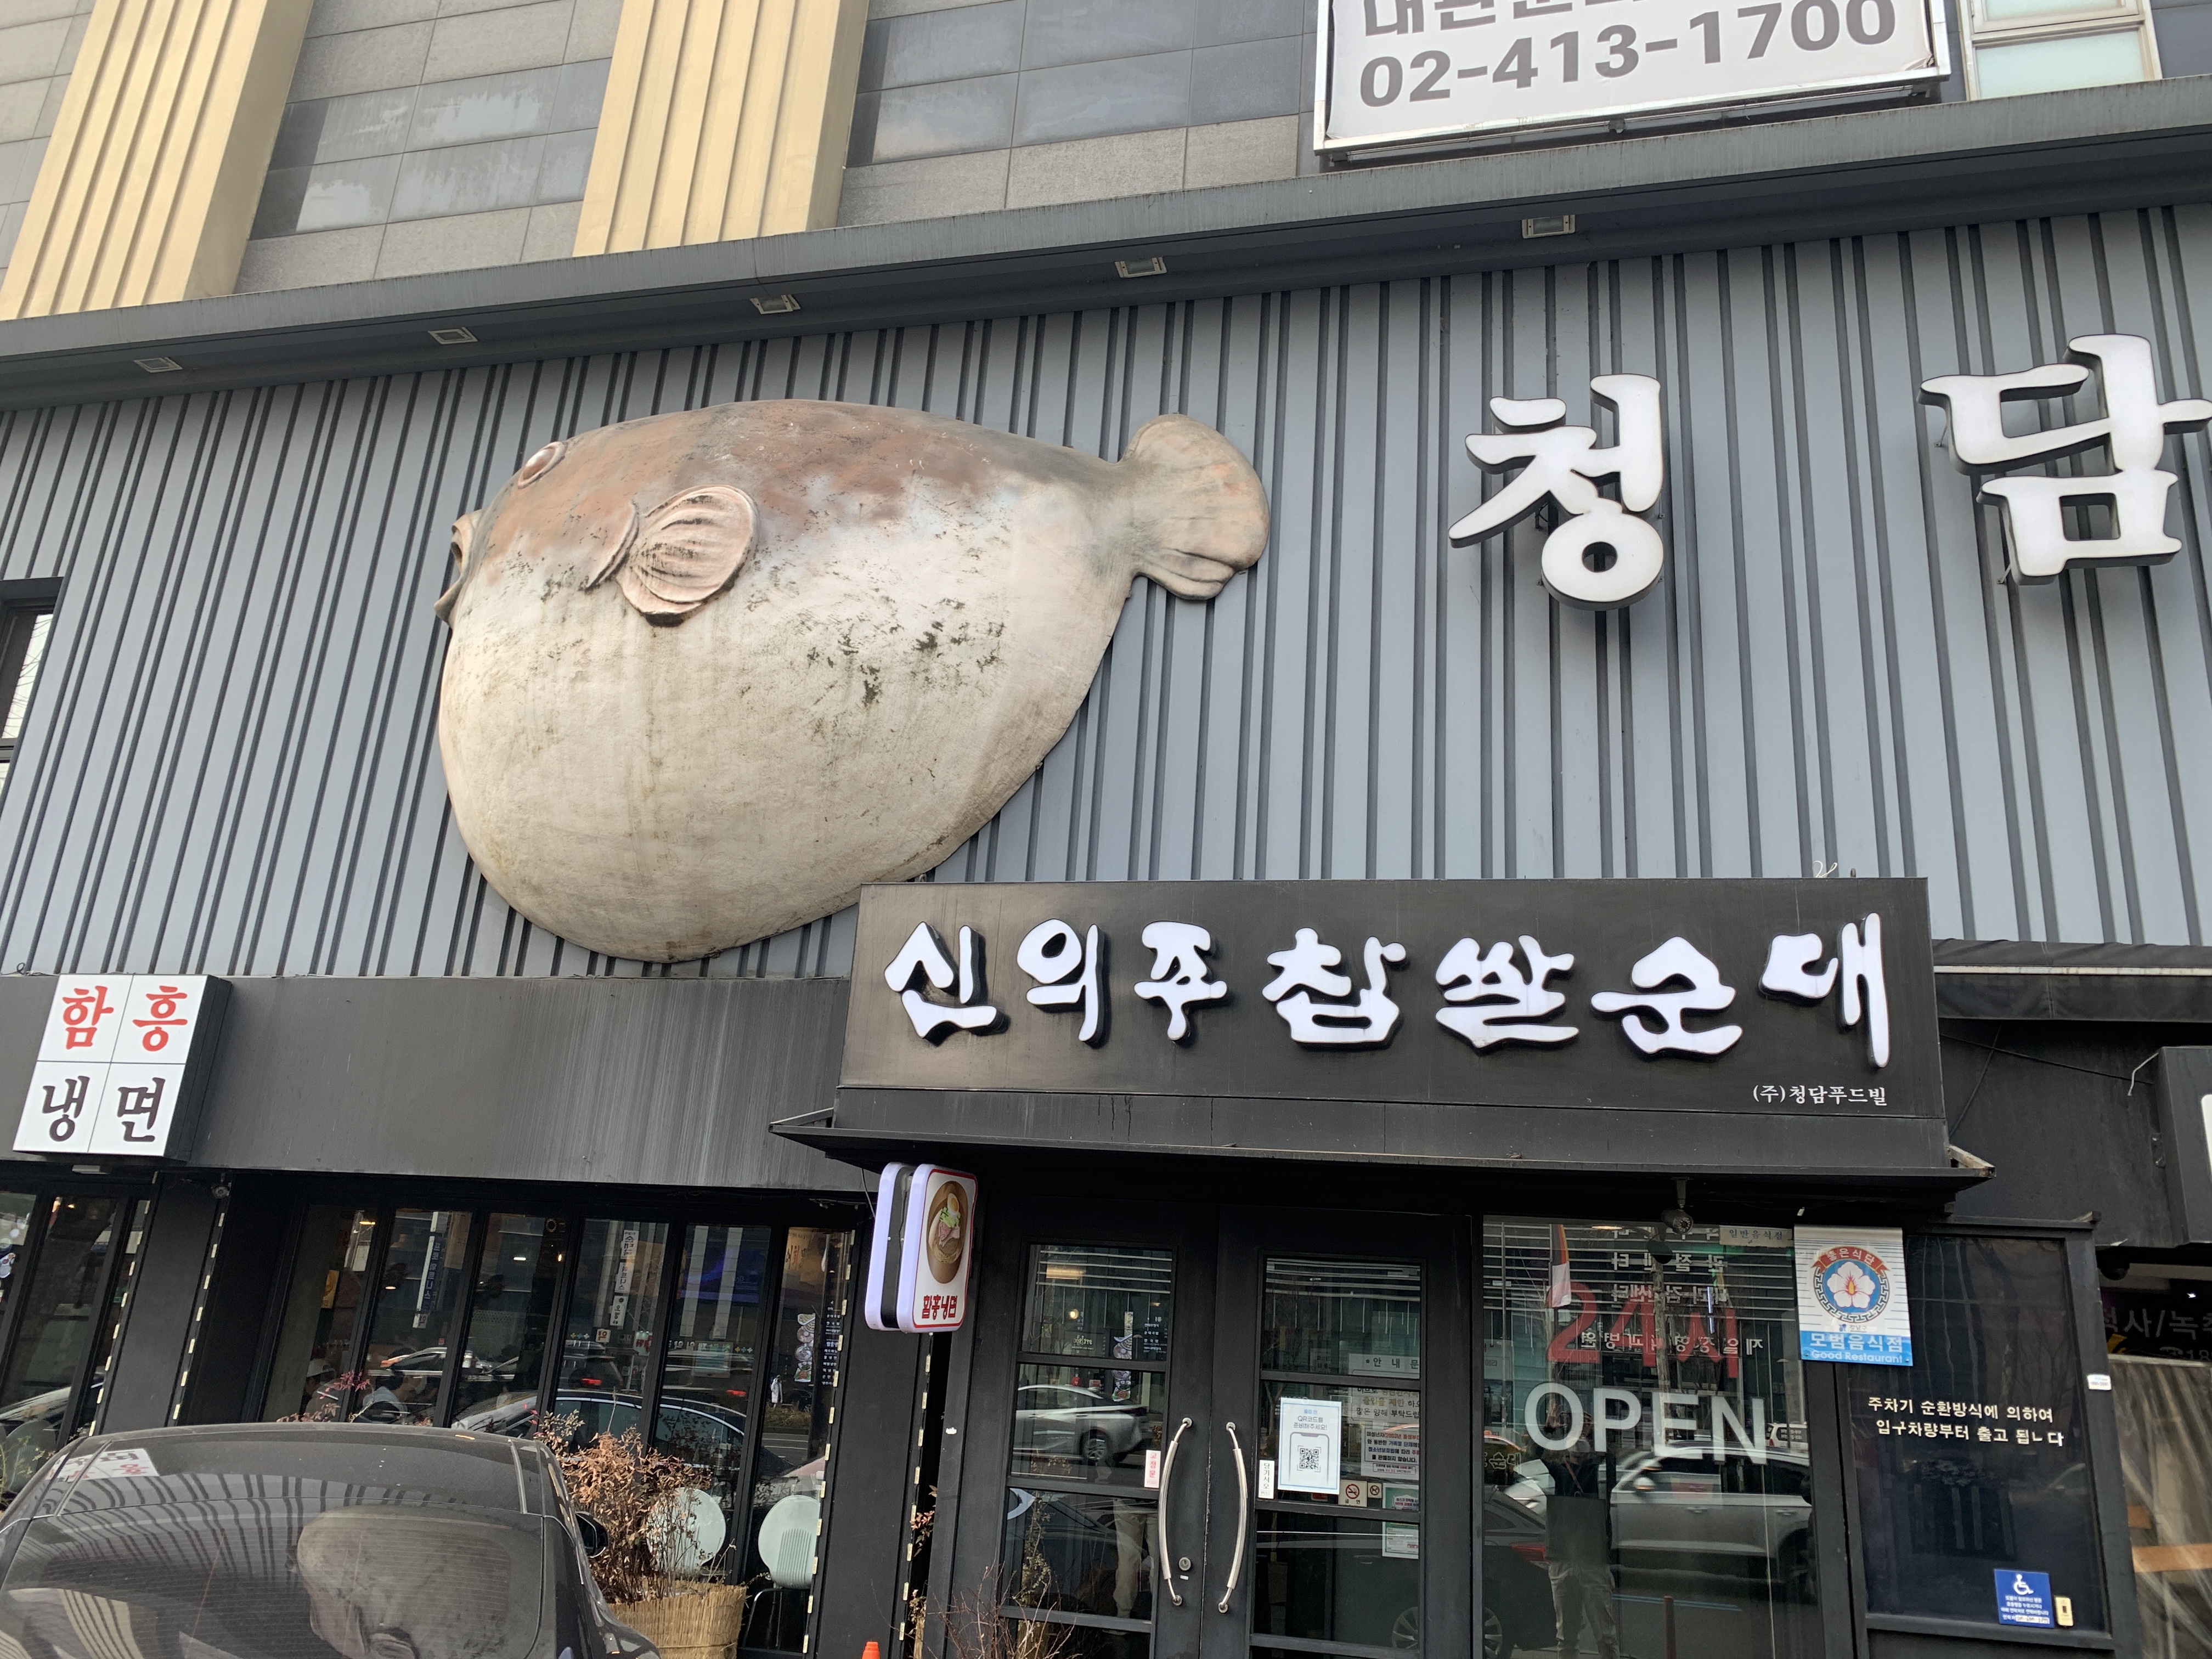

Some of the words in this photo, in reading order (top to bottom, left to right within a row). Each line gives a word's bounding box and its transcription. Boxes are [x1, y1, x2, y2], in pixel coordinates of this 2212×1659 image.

[1360, 0, 1895, 107] 02-413-1700
[1448, 334, 2212, 606] 청담
[62, 985, 188, 1052] 함흥
[42, 1075, 166, 1142] 냉면
[1753, 1084, 1888, 1107] (주)청담푸드빌
[1729, 1229, 1782, 1240] 일반음식점
[922, 1295, 958, 1321] 함흥냉면
[1810, 1333, 1903, 1353] 모범음식점
[1811, 1350, 1842, 1360] Good
[1845, 1352, 1903, 1364] Restaurant
[1868, 1397, 1914, 1414] 주차기
[1921, 1400, 1999, 1420] 순환방식에
[2006, 1406, 2053, 1423] 의하여
[1294, 1422, 1328, 1430] 준비해주세요!
[1524, 1382, 1768, 1466] OPEN
[1876, 1419, 1969, 1440] 입구차량부터
[1977, 1427, 2008, 1442] 출고
